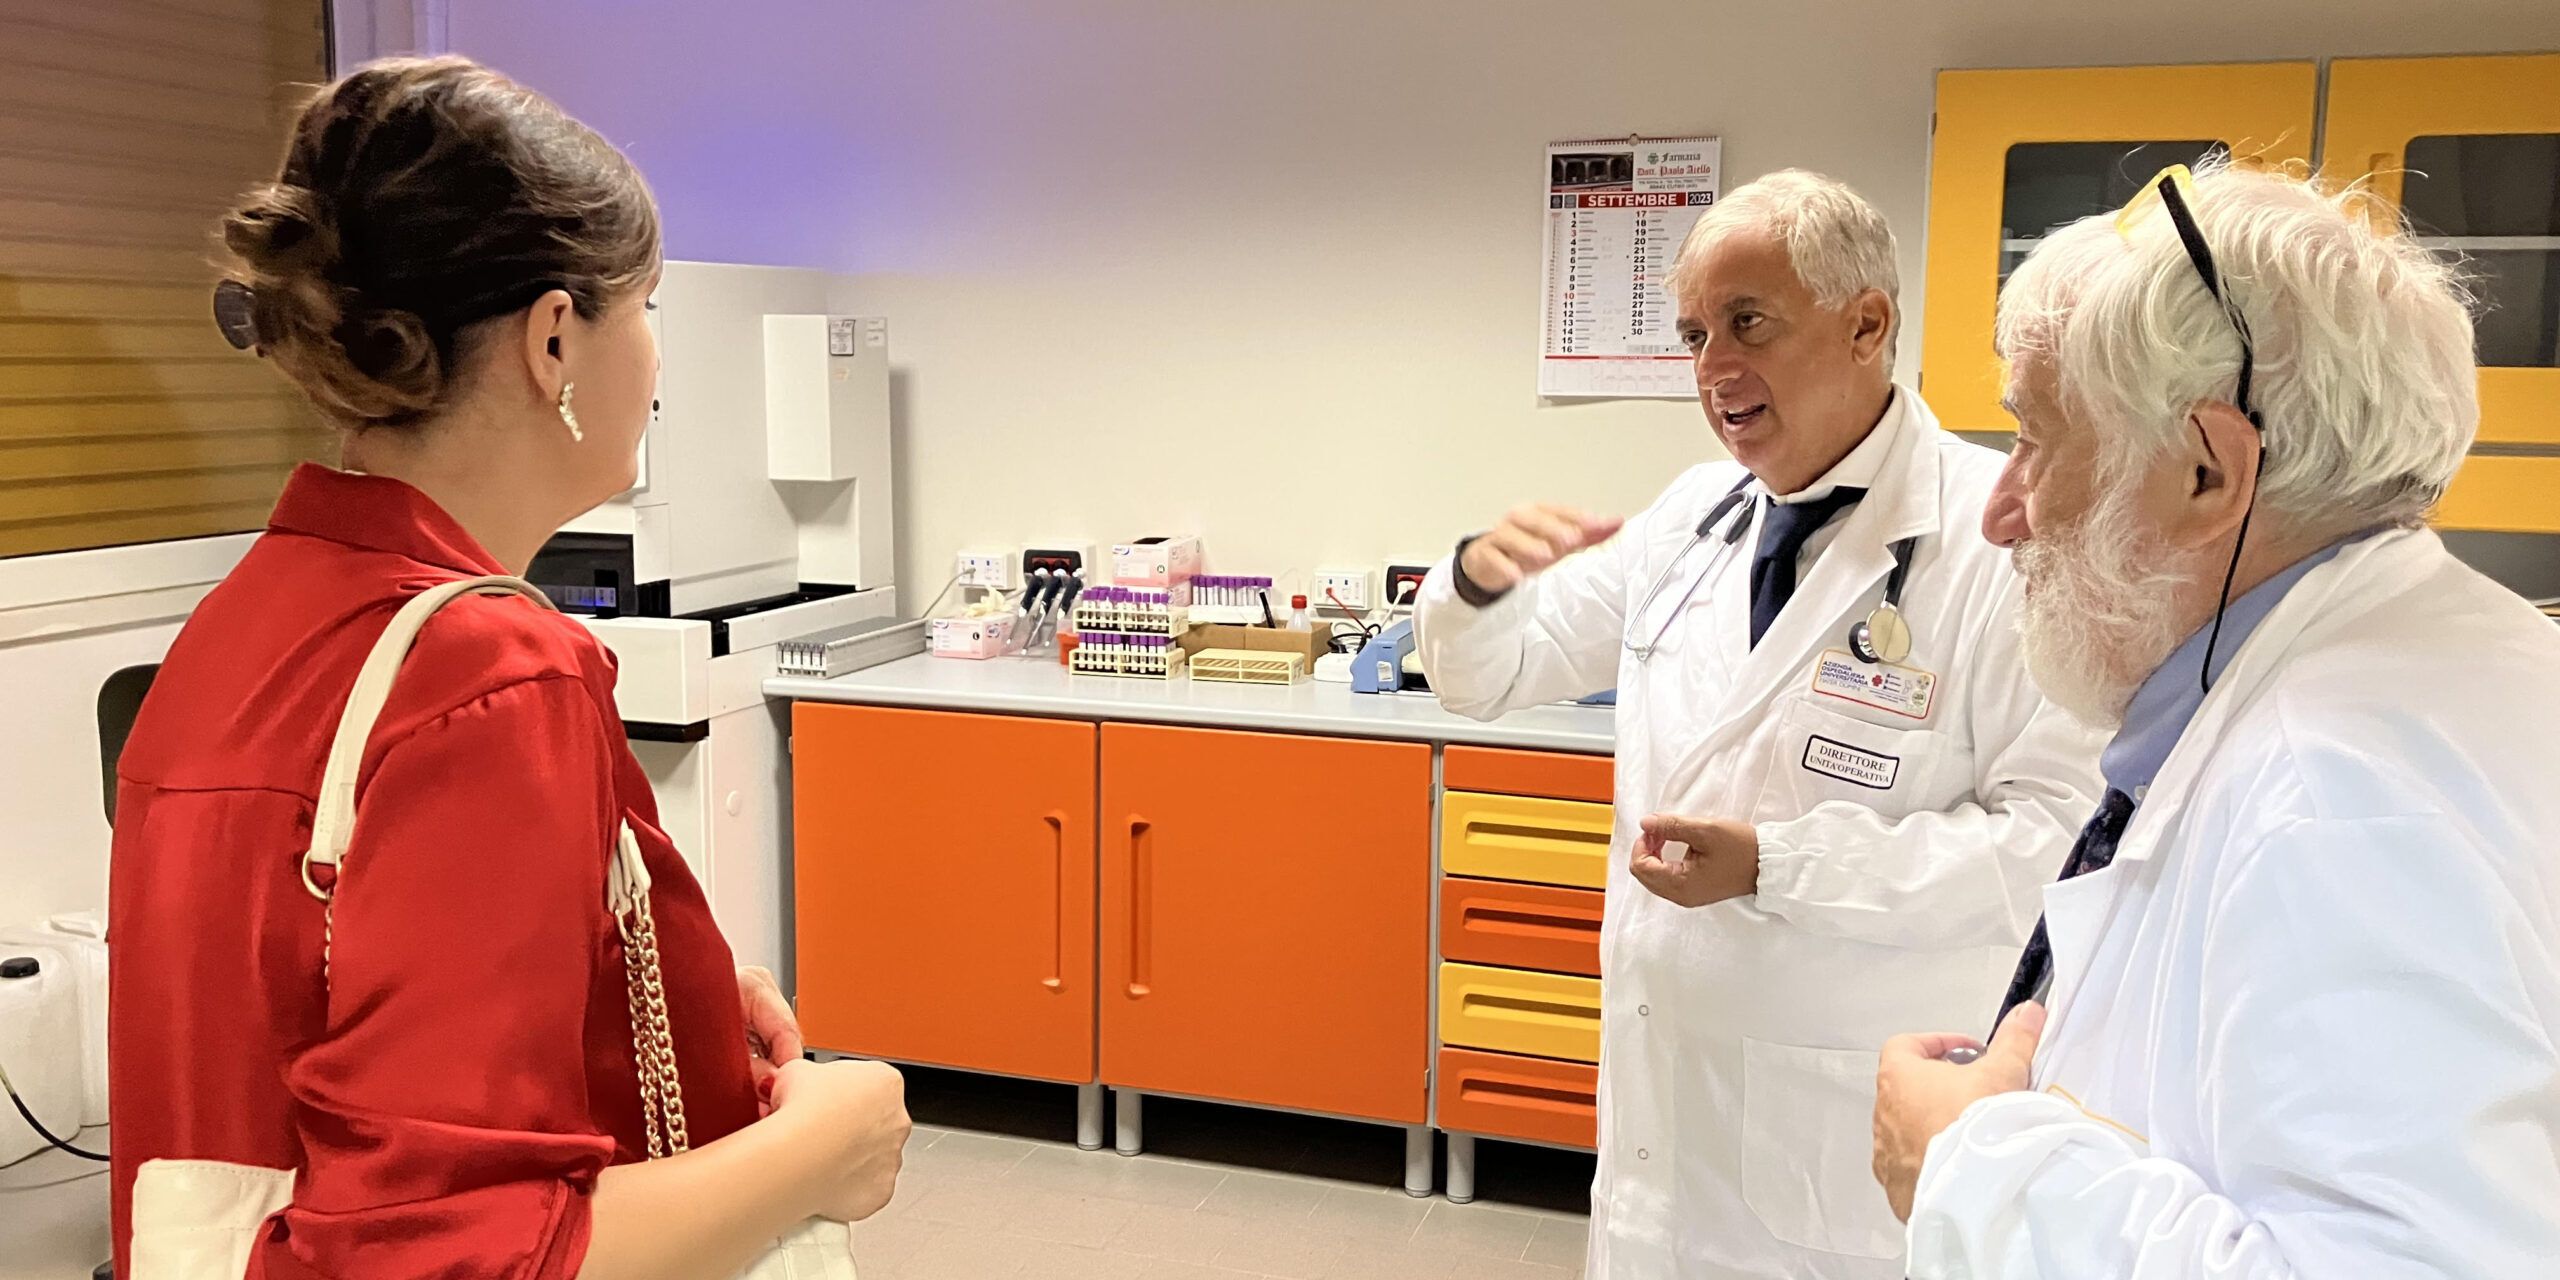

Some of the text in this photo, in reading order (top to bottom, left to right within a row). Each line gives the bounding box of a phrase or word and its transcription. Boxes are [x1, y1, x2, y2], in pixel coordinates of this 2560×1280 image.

[1660, 166, 1685, 176] Paolo
[1686, 164, 1711, 174] Aiello
[1588, 193, 1712, 207] SETTEMBRE 2023
[1636, 210, 1647, 218] 17
[1635, 219, 1647, 227] 18
[1635, 228, 1646, 236] 19
[1634, 237, 1646, 245] 20
[1633, 246, 1645, 254] 21
[1633, 255, 1645, 263] 22
[1633, 264, 1645, 272] 23
[1633, 273, 1645, 281] 24
[1564, 292, 1575, 300] 10
[1632, 291, 1644, 299] 26
[1563, 301, 1573, 309] 11
[1632, 300, 1644, 308] 27
[1563, 310, 1574, 318] 12
[1631, 309, 1643, 317] 28
[1562, 319, 1573, 327] 13
[1631, 318, 1643, 327] 29
[1562, 336, 1573, 344] 15
[1561, 345, 1573, 353] 16
[1823, 661, 1852, 671] AZIENDA
[1821, 666, 1865, 679] OSPEDALIERA
[1820, 671, 1868, 685] UNIVERSITARIA
[1819, 745, 1887, 772] DIRETTORE
